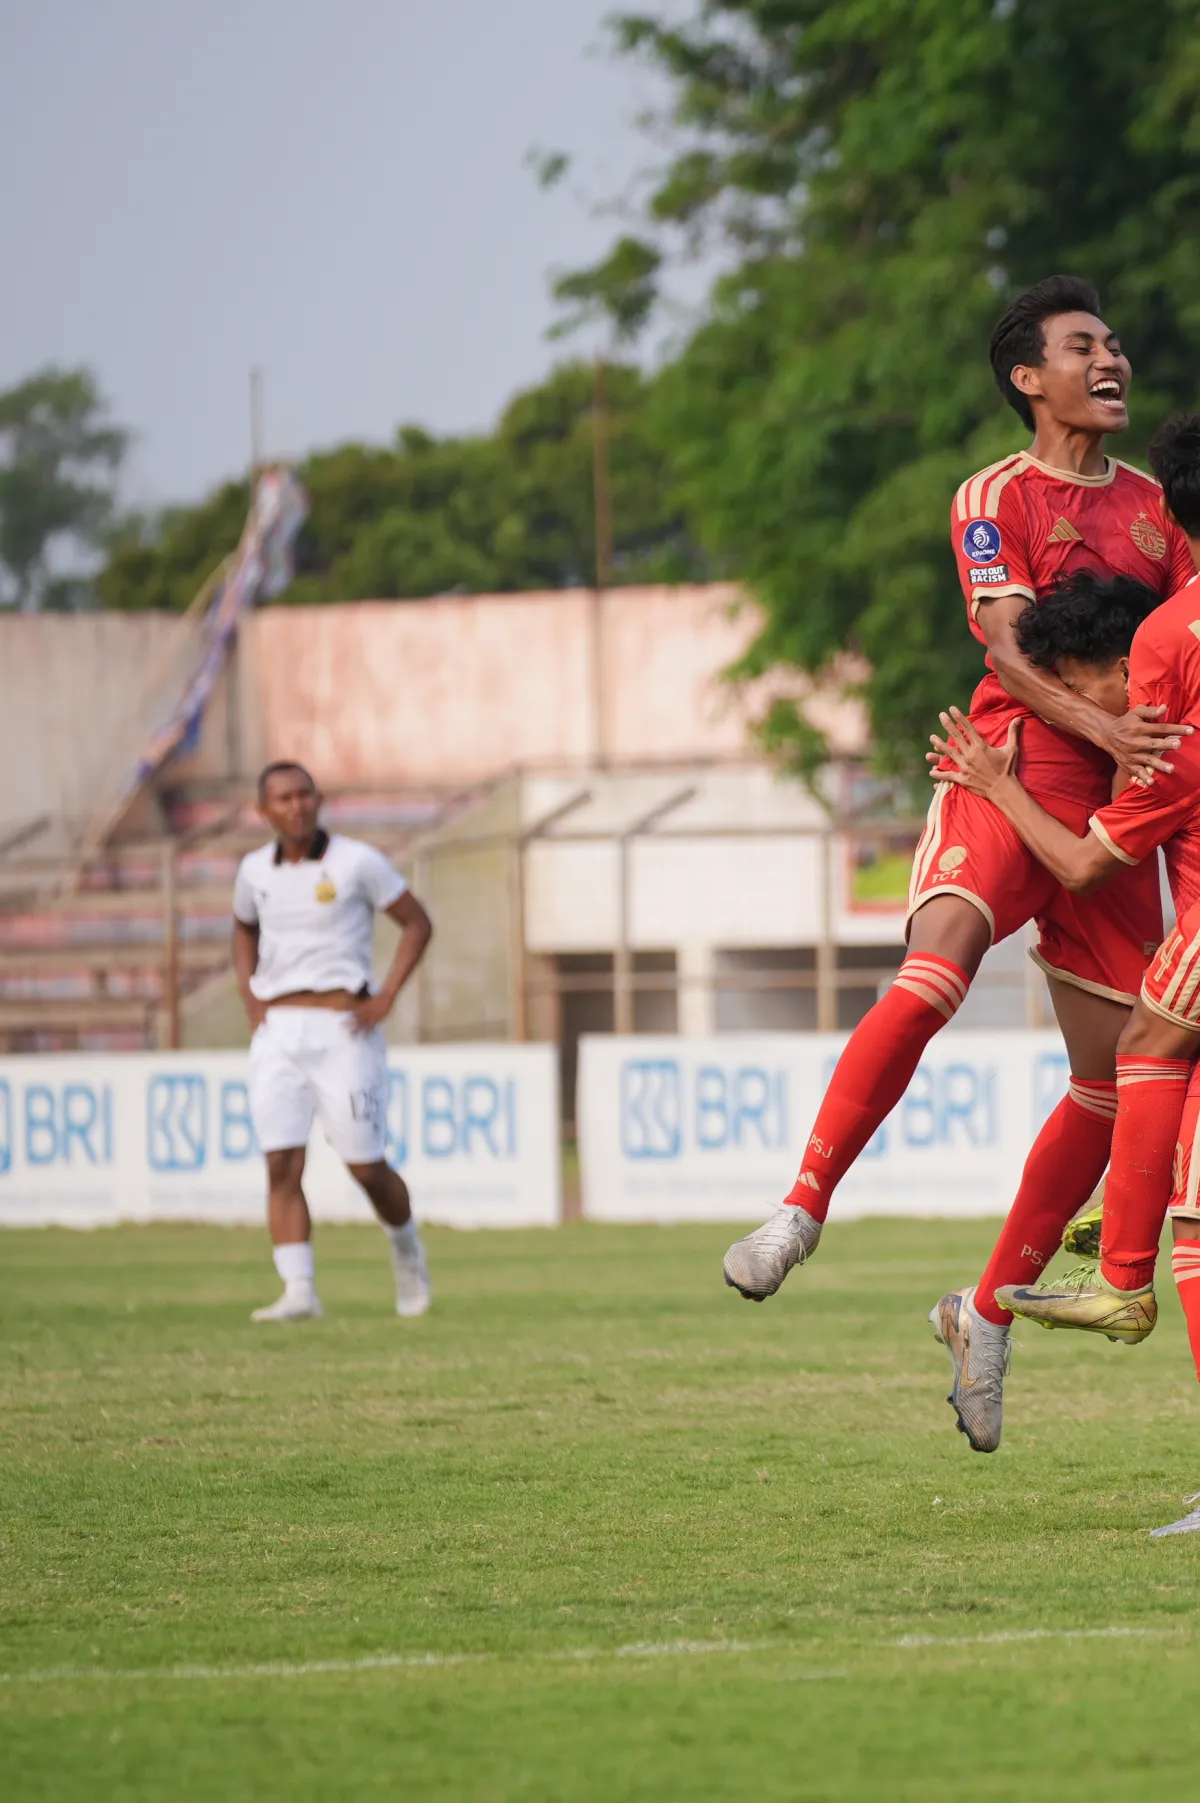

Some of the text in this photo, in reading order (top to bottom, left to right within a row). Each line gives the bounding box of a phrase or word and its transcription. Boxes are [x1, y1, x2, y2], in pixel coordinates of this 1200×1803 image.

[969, 565, 1004, 577] KICK OUT
[971, 573, 1007, 584] RACISM
[931, 869, 963, 884] TCT
[24, 1083, 113, 1164] BRI
[421, 1077, 518, 1160] BRI
[695, 1066, 789, 1150] BRI
[899, 1063, 998, 1148] BRI
[809, 1133, 833, 1159] PSJ
